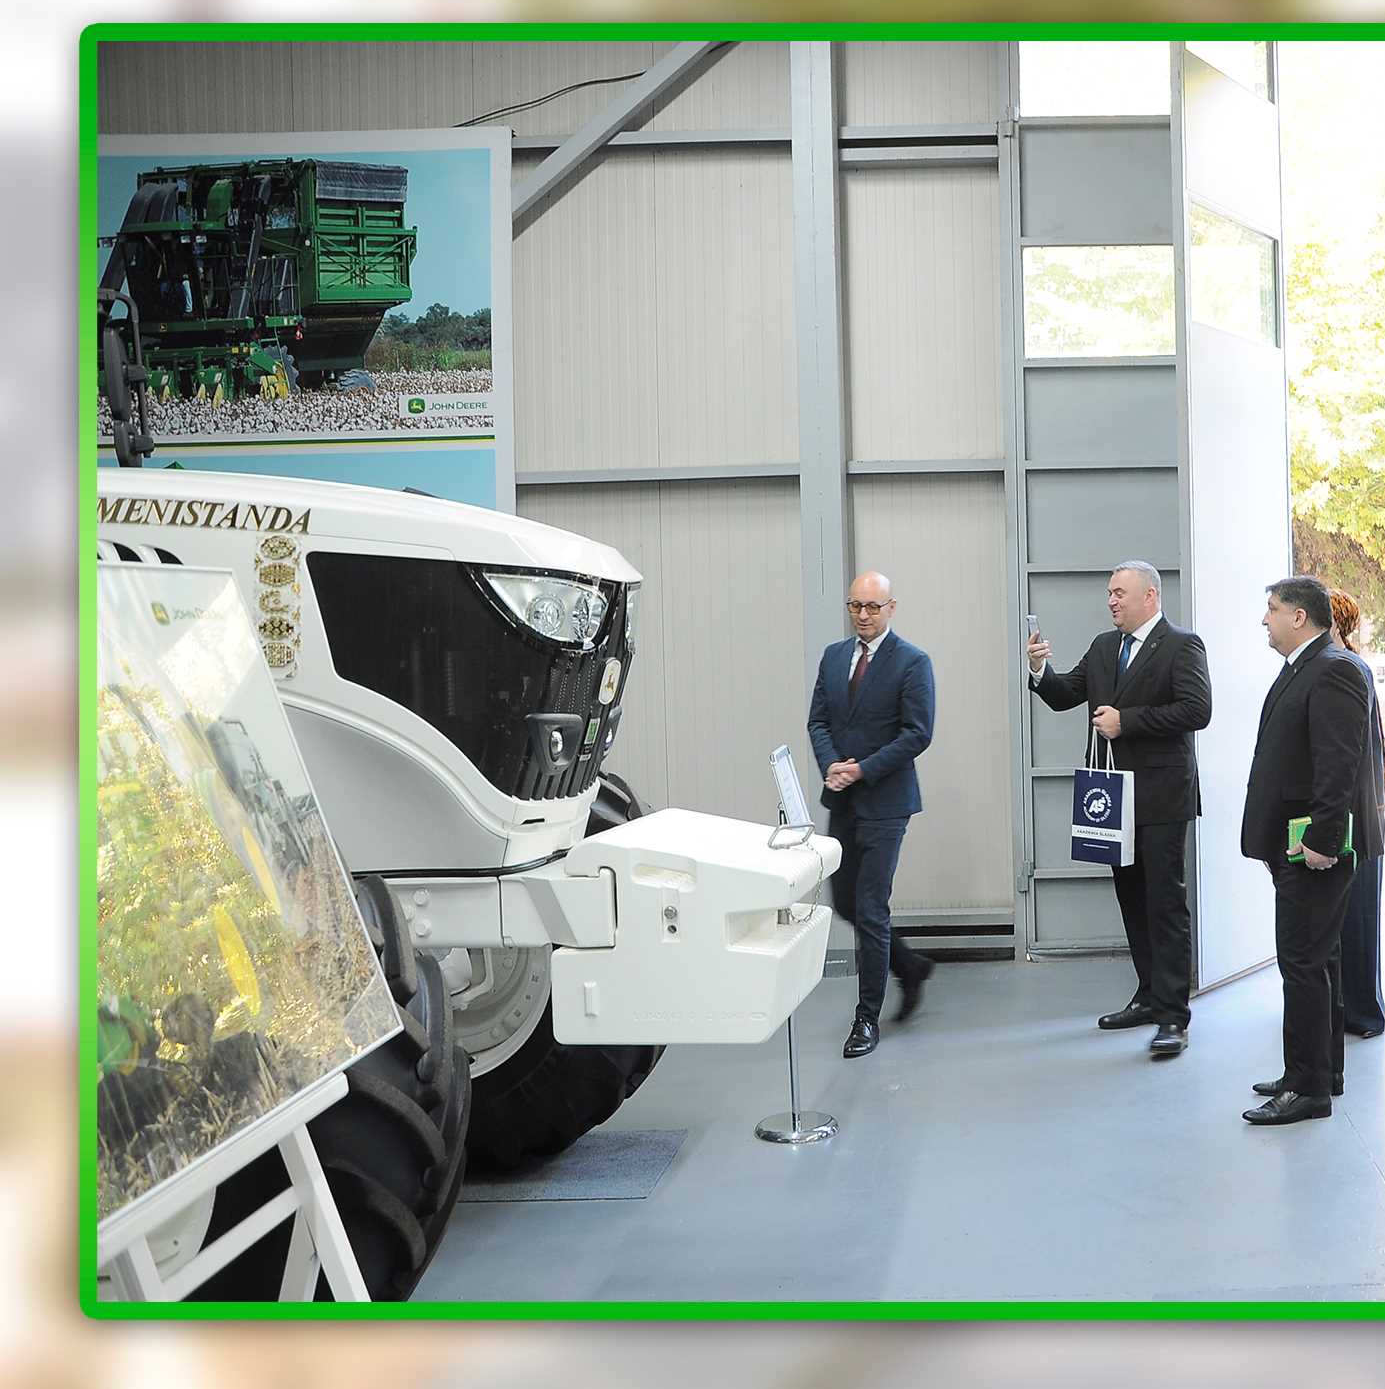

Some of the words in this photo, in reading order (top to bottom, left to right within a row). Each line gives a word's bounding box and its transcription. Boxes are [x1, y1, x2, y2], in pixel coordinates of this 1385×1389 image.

[429, 402, 455, 410] JOHN
[456, 401, 488, 410] DEERE
[97, 497, 311, 534] MENISTANDA
